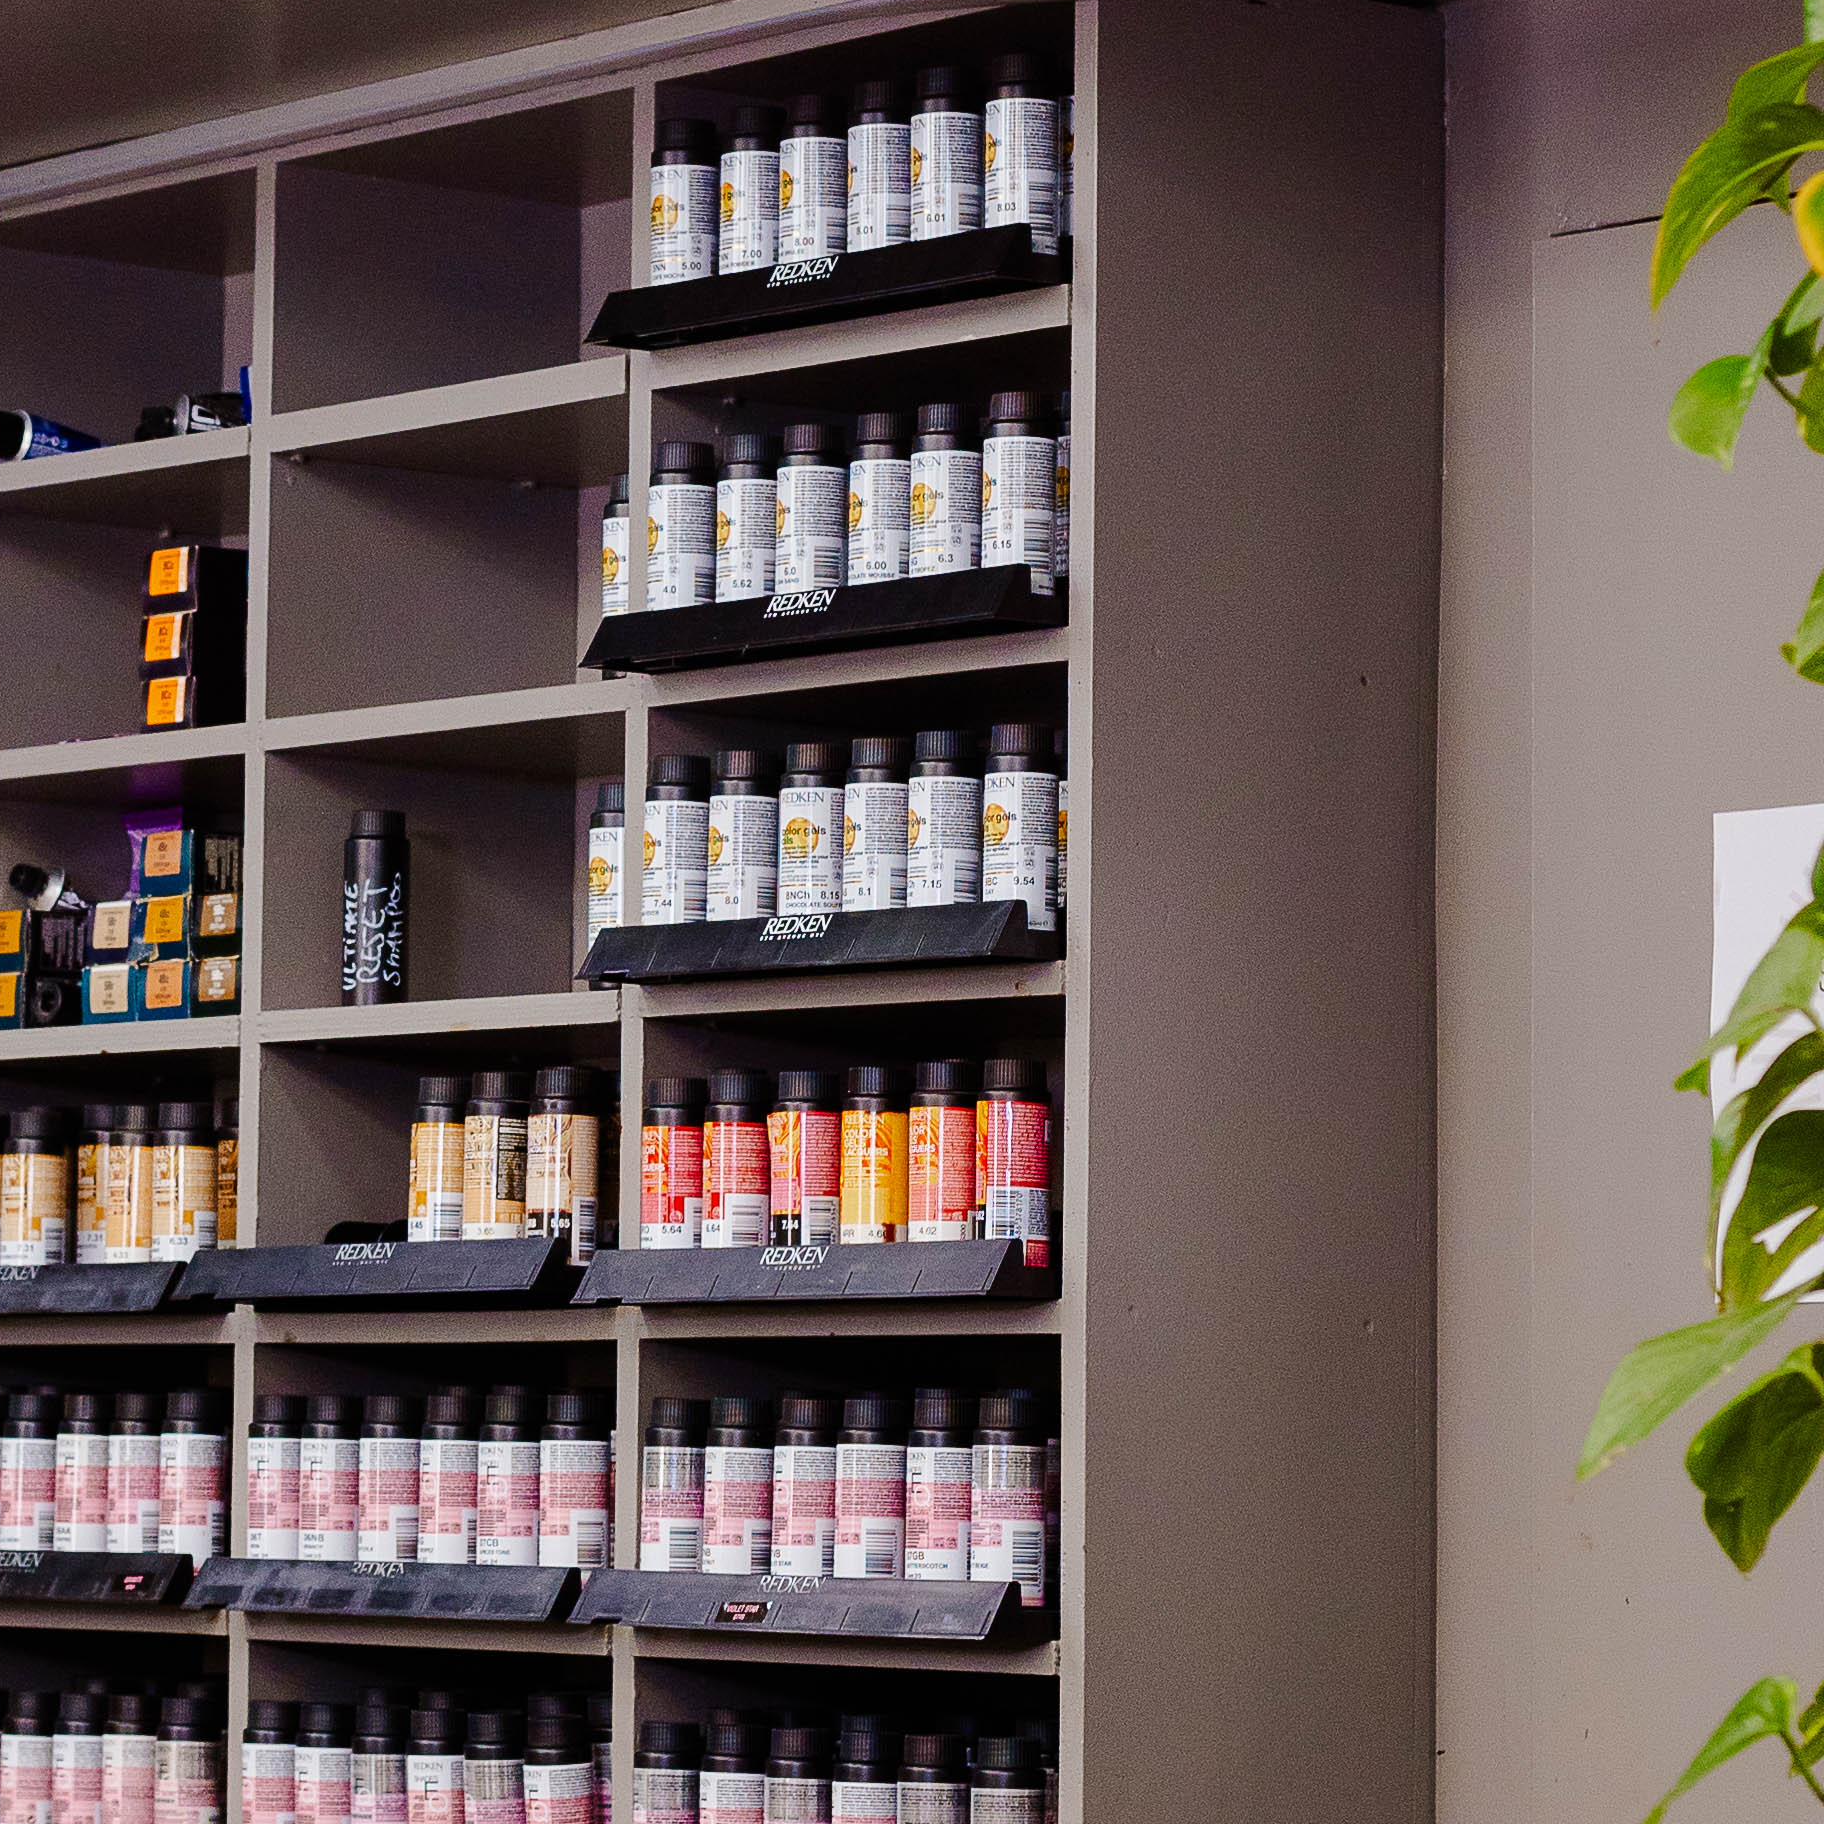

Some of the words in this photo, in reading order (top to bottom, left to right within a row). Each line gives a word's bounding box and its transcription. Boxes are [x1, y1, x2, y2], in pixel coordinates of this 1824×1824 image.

[742, 249, 762, 258] 7.00
[681, 262, 702, 271] 5.00
[769, 256, 839, 283] REDKEN
[938, 553, 954, 563] 6.3
[766, 588, 837, 613] REDKEN
[782, 792, 824, 803] REDKEN
[921, 880, 942, 889] 7.15
[821, 890, 840, 900] 8.15
[858, 887, 871, 896] 8.1
[654, 899, 672, 908] 7.44
[724, 895, 739, 905] 8.0
[762, 914, 833, 935] REDKEN
[356, 878, 388, 983] RESET
[662, 1226, 682, 1234] 5.64
[335, 1242, 396, 1261] REDKEN
[759, 1246, 829, 1266] REDKEN
